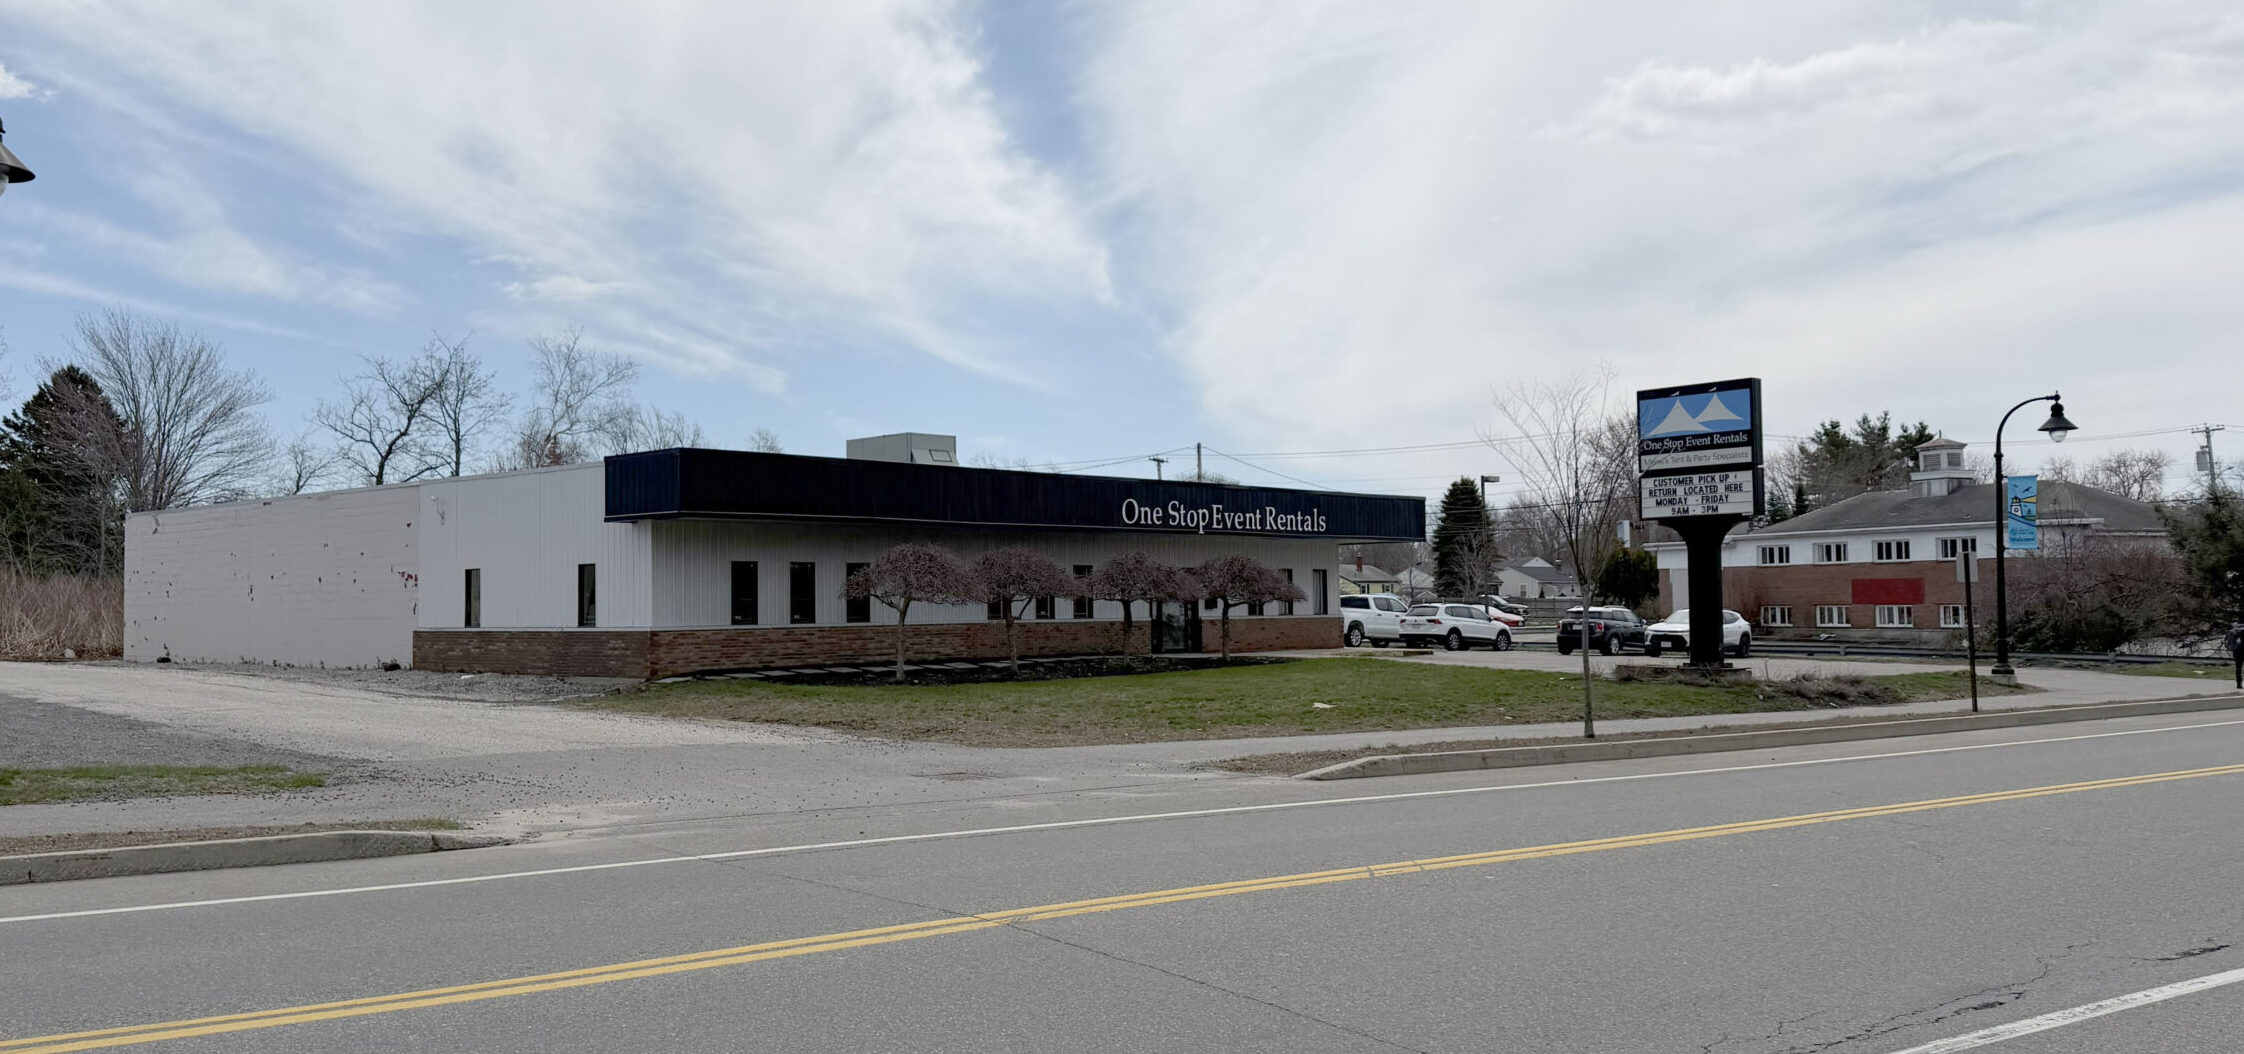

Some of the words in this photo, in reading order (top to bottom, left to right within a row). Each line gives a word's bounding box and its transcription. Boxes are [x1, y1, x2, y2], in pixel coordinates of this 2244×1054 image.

[1643, 441, 1662, 450] One
[1663, 439, 1684, 451] Stop
[1686, 436, 1710, 447] Event
[1714, 432, 1747, 444] Rentals
[1694, 454, 1710, 462] Party
[1653, 477, 1694, 487] CUSTOMER
[1699, 475, 1715, 483] PICK
[1649, 488, 1676, 498] RETURN
[1684, 485, 1718, 494] LOCATED
[1725, 483, 1743, 491] HERE
[1656, 497, 1688, 507] MONDAY
[1702, 495, 1729, 503] FRIDAY
[1122, 498, 1163, 525] One
[1168, 500, 1209, 534] Stop
[1212, 505, 1262, 530] Event
[1265, 507, 1326, 532] Rentals
